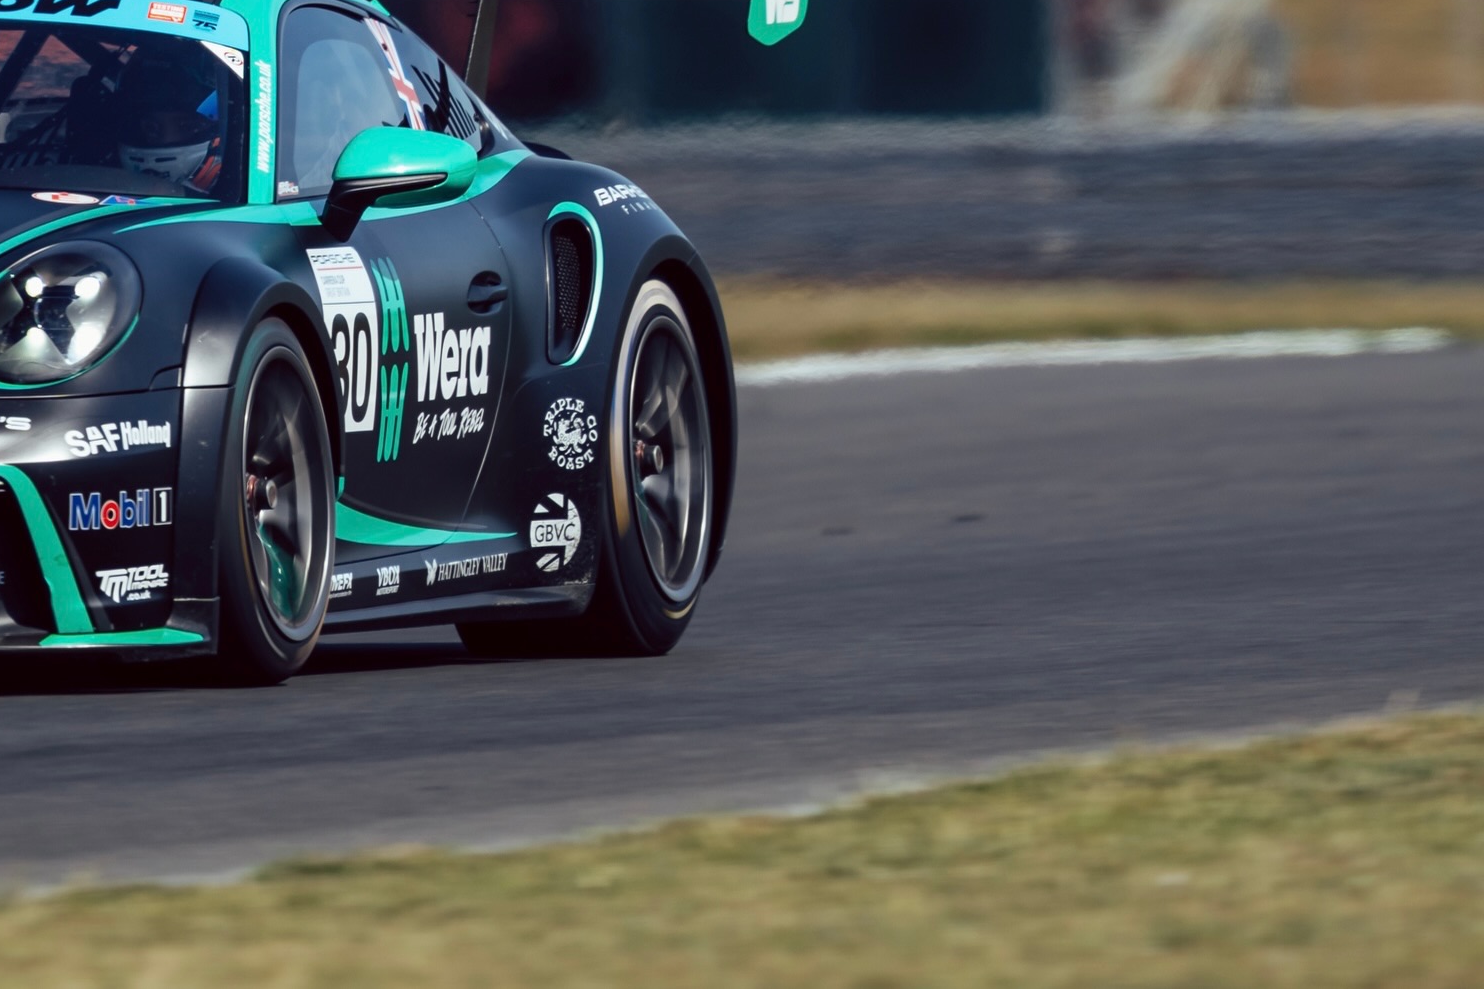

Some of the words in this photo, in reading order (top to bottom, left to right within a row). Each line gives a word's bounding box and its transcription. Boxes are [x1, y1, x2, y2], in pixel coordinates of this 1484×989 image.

[193, 19, 217, 30] 75
[331, 312, 372, 422] 30
[414, 312, 491, 402] Wera
[543, 397, 584, 437] TRIPLE
[65, 423, 120, 457] SAF
[548, 445, 594, 470] ROAST
[69, 488, 150, 531] Mobil
[535, 522, 576, 542] GBVC
[377, 565, 400, 587] VBOX
[437, 557, 482, 581] HATTINGLEY
[482, 552, 509, 573] VALLEY
